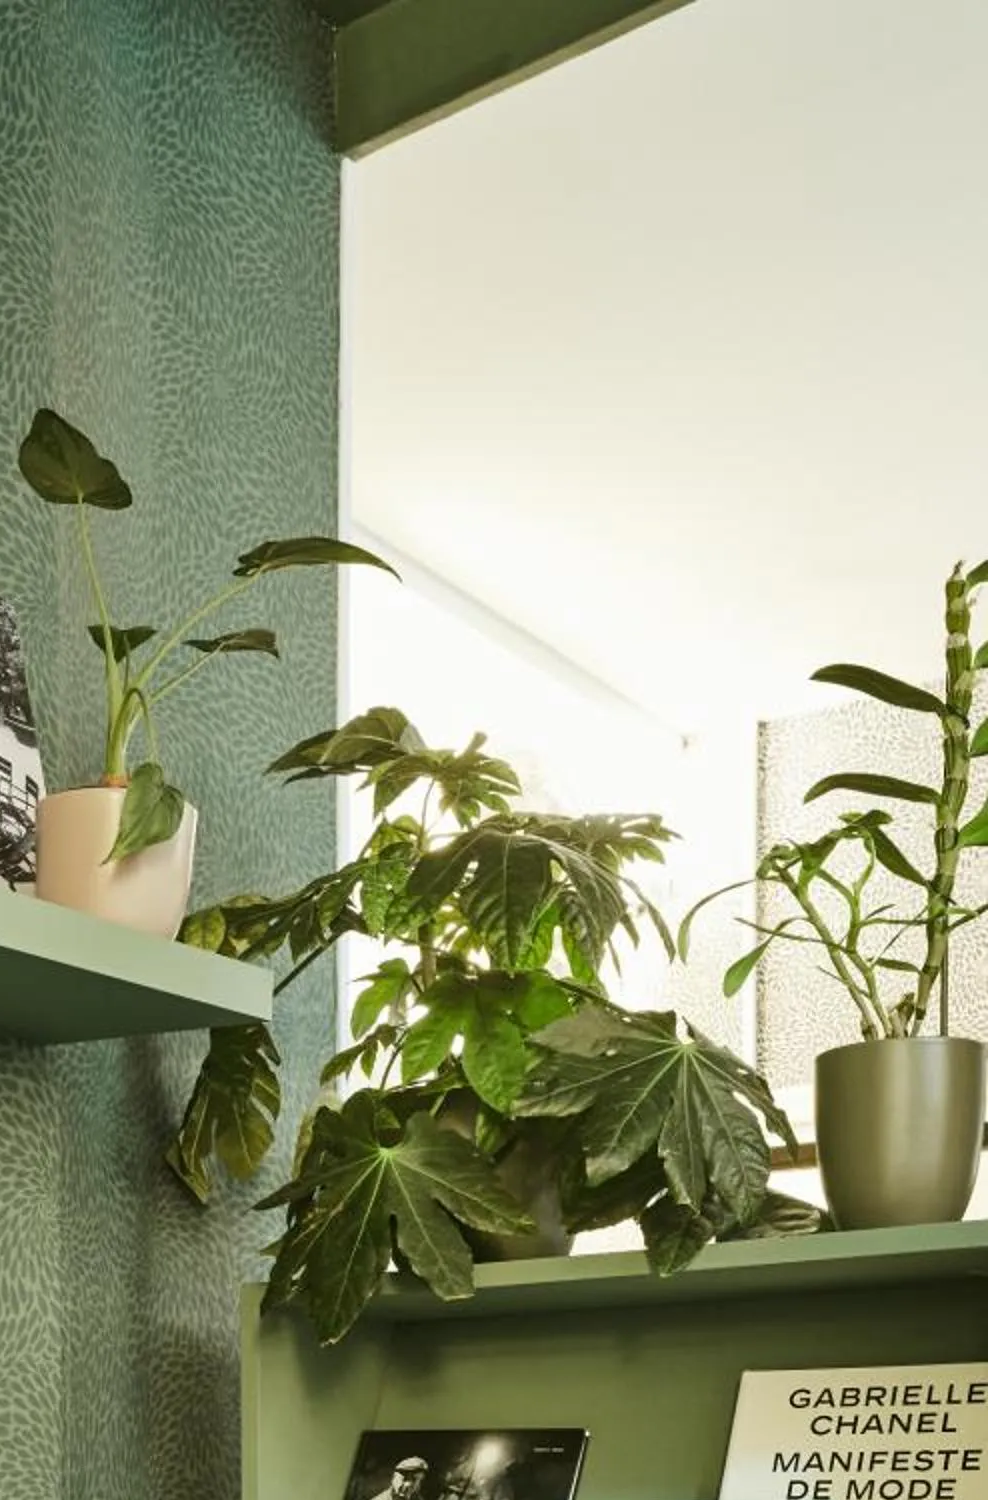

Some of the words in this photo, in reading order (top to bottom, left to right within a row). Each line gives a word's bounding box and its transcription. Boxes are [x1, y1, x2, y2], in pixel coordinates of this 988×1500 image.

[789, 1383, 988, 1409] GABRIELLE
[810, 1412, 957, 1436] CHANEL
[772, 1449, 983, 1473] MANIFESTE
[786, 1479, 833, 1500] DE
[845, 1479, 957, 1500] MODE
